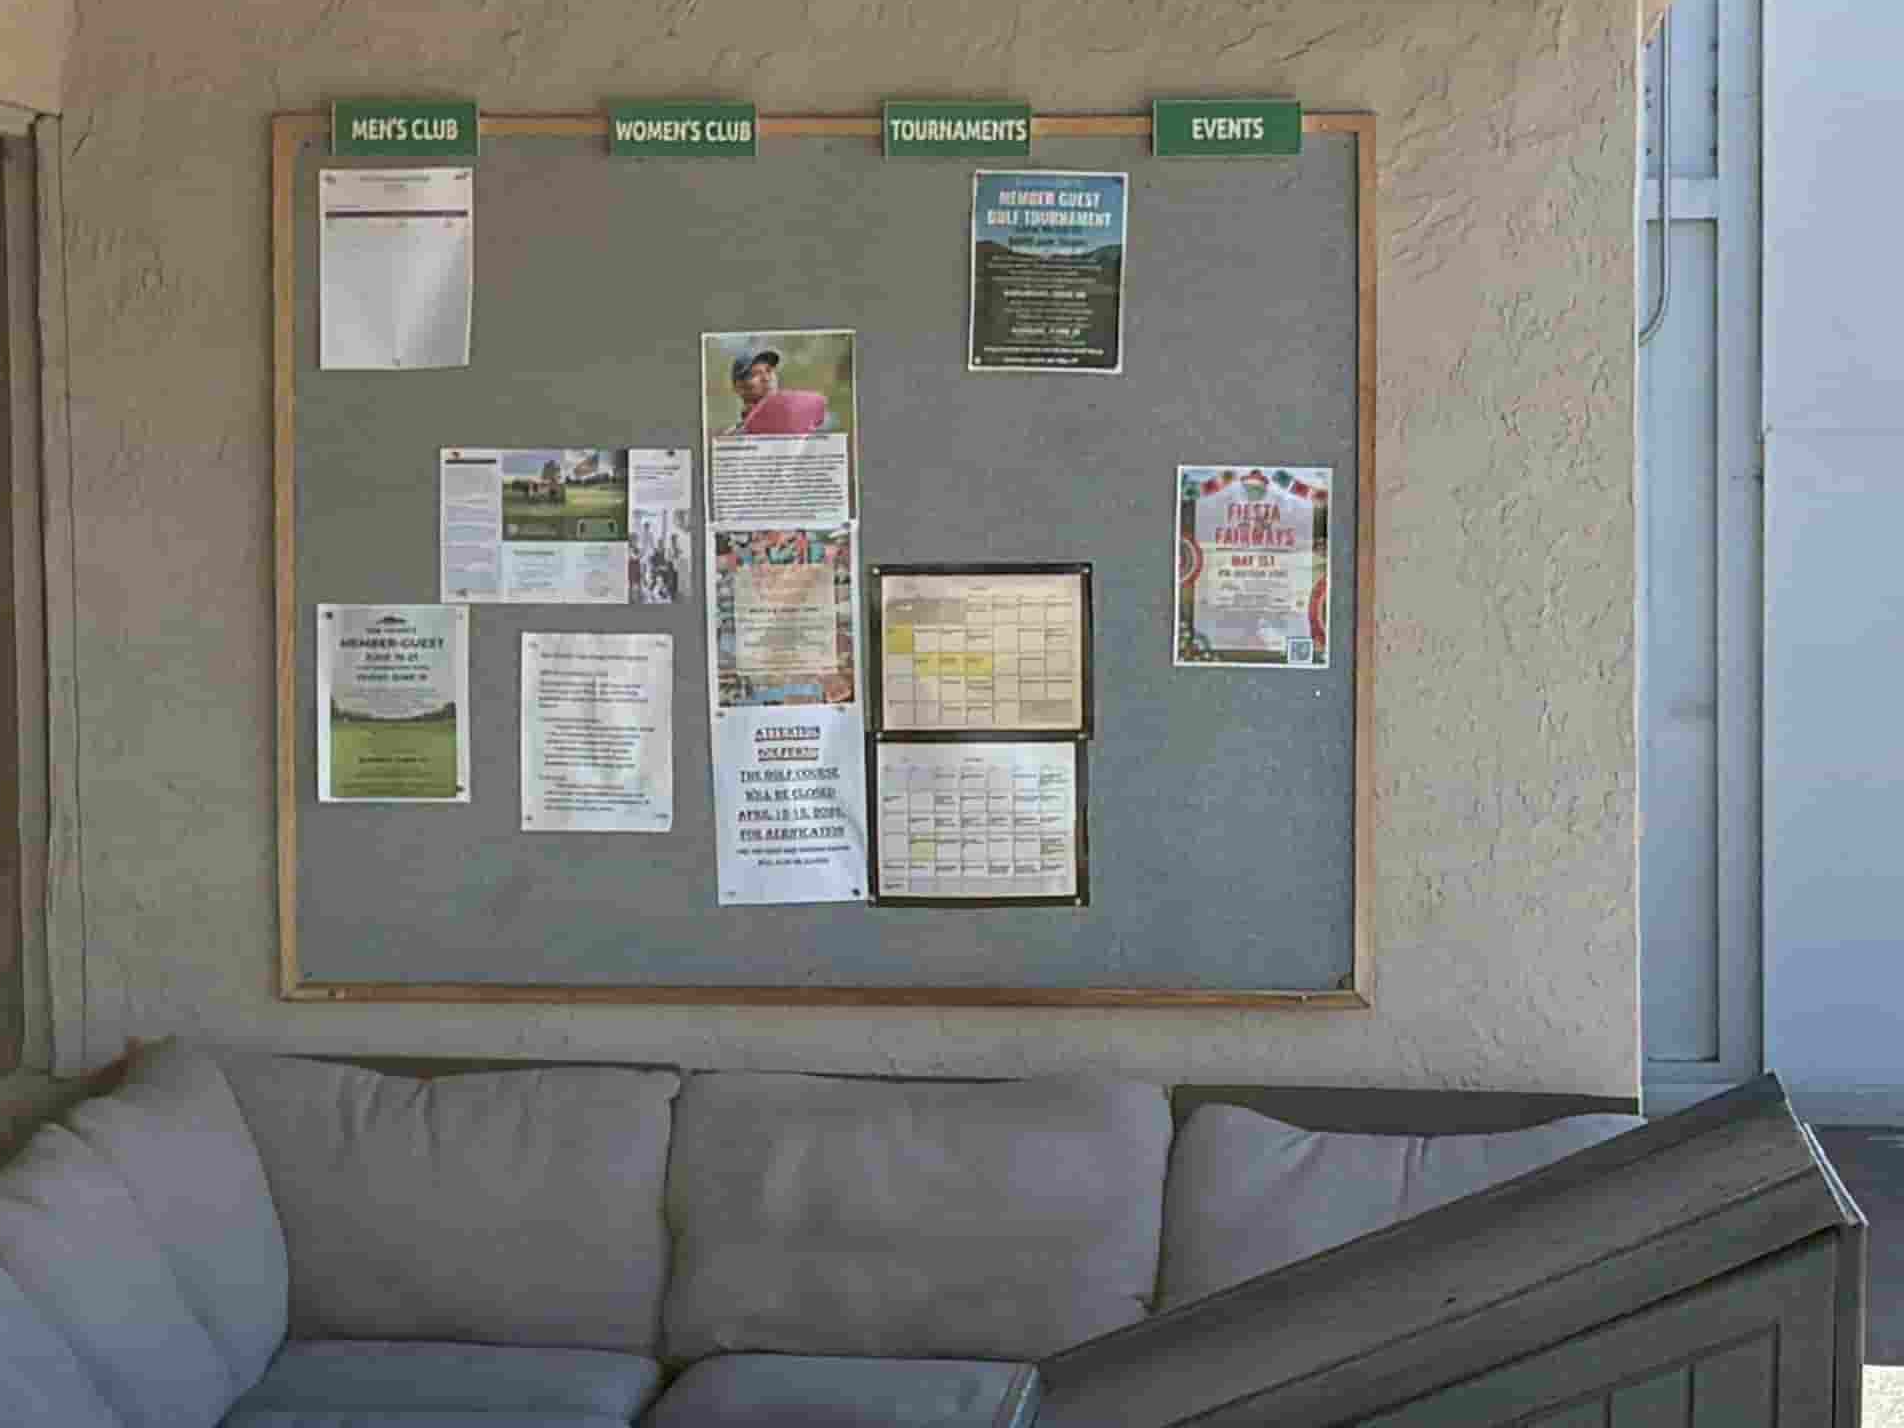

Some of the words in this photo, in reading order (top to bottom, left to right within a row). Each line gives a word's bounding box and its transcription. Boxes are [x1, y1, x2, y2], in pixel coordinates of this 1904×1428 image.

[351, 117, 408, 141] MEN'S
[411, 118, 458, 141] CLUB
[615, 120, 702, 142] WOMEN'S
[705, 121, 752, 142] CLUB
[890, 117, 1027, 141] TOURNAMENTS
[1191, 116, 1264, 140] EVENTS
